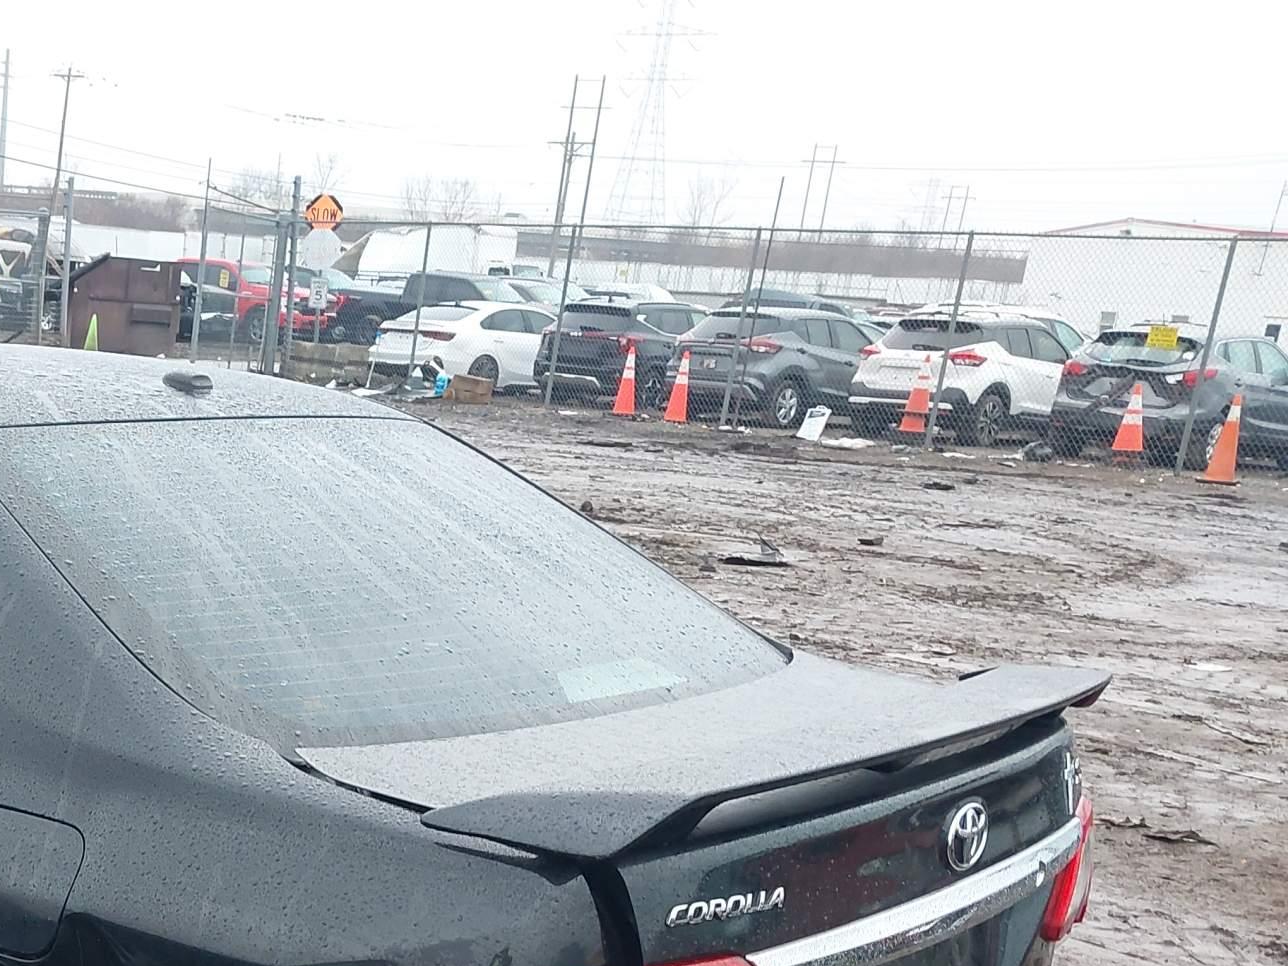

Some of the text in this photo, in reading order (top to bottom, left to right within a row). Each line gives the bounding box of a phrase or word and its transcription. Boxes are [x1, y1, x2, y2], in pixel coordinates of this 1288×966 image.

[311, 207, 338, 222] SLOW
[314, 290, 323, 301] 5
[666, 886, 785, 927] COROLLA
